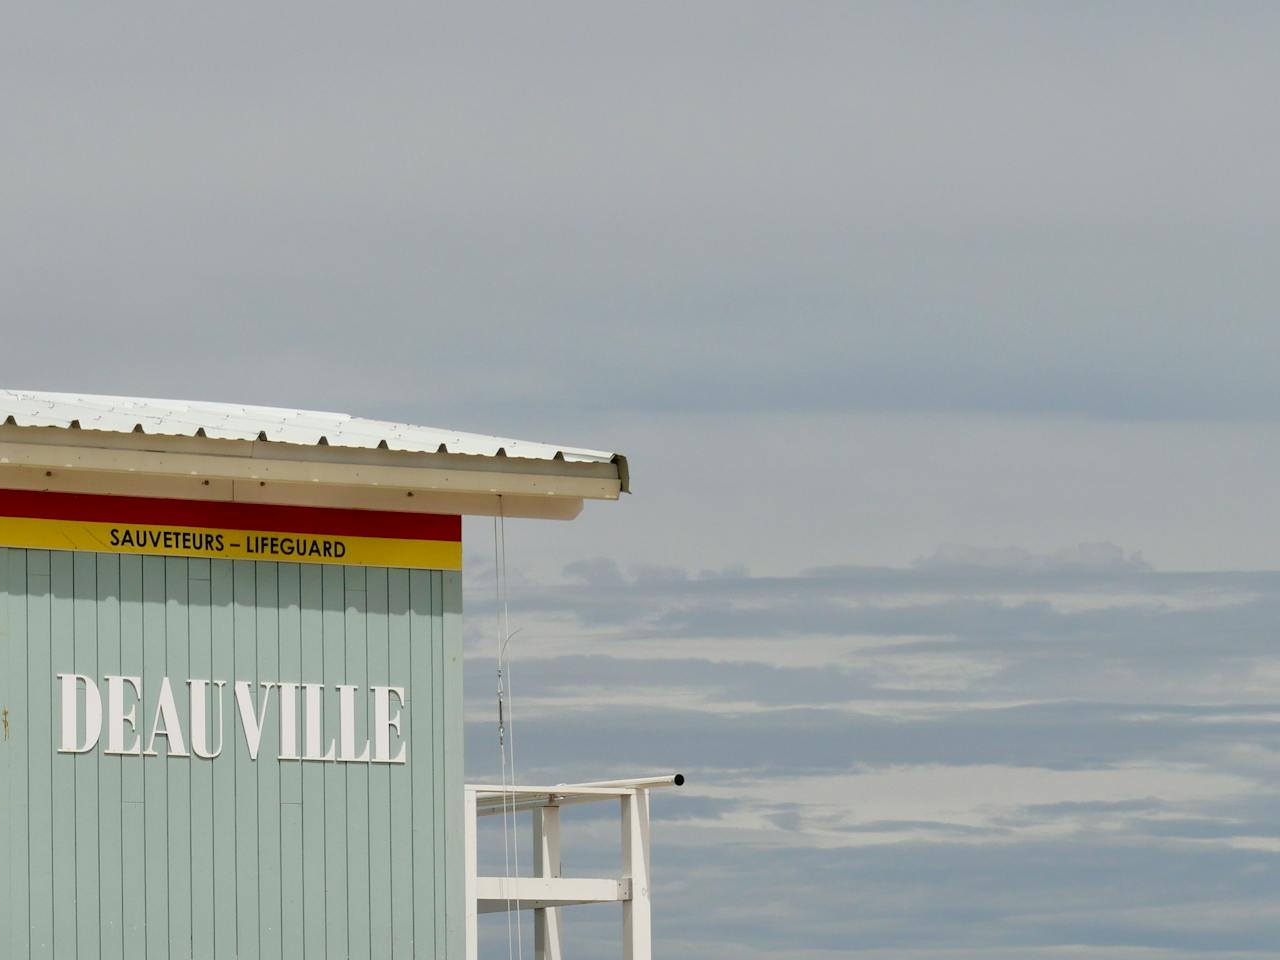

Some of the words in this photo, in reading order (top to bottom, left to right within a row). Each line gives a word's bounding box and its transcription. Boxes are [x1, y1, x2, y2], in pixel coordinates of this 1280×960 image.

[110, 528, 224, 552] SAUVETEURS
[246, 536, 346, 558] LIFEGUARD
[56, 672, 407, 764] DEAUVILLE
